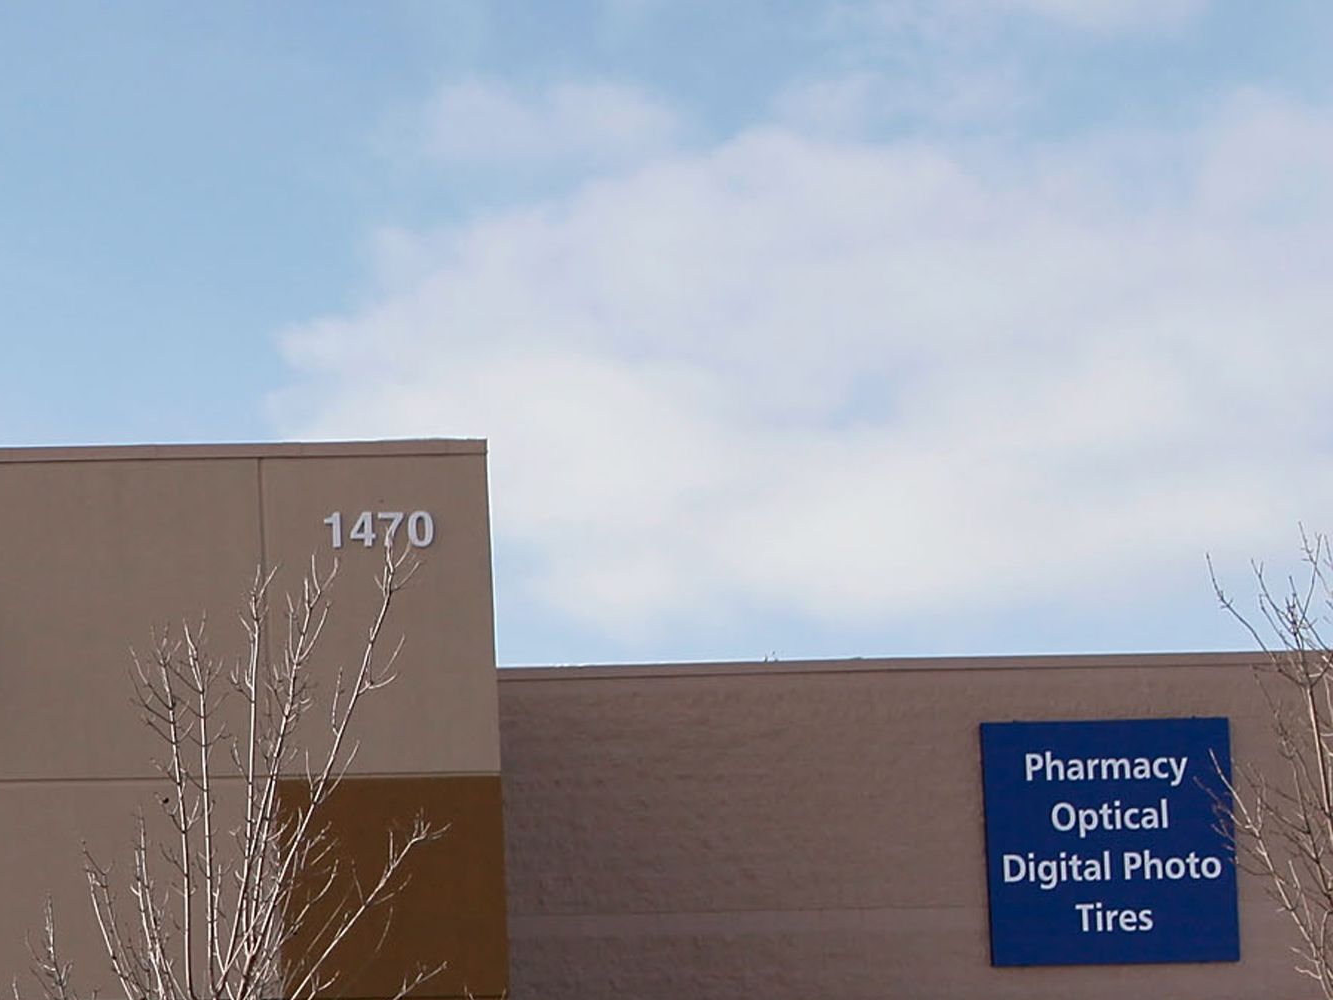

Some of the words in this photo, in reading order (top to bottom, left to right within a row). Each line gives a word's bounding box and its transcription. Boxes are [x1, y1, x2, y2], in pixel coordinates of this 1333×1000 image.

[323, 511, 434, 548] 1470
[1025, 751, 1189, 787] Pharmacy
[1051, 798, 1169, 838] Optical
[1003, 850, 1111, 890] Digital
[1123, 850, 1222, 880] Photo
[1075, 902, 1154, 932] Tires
